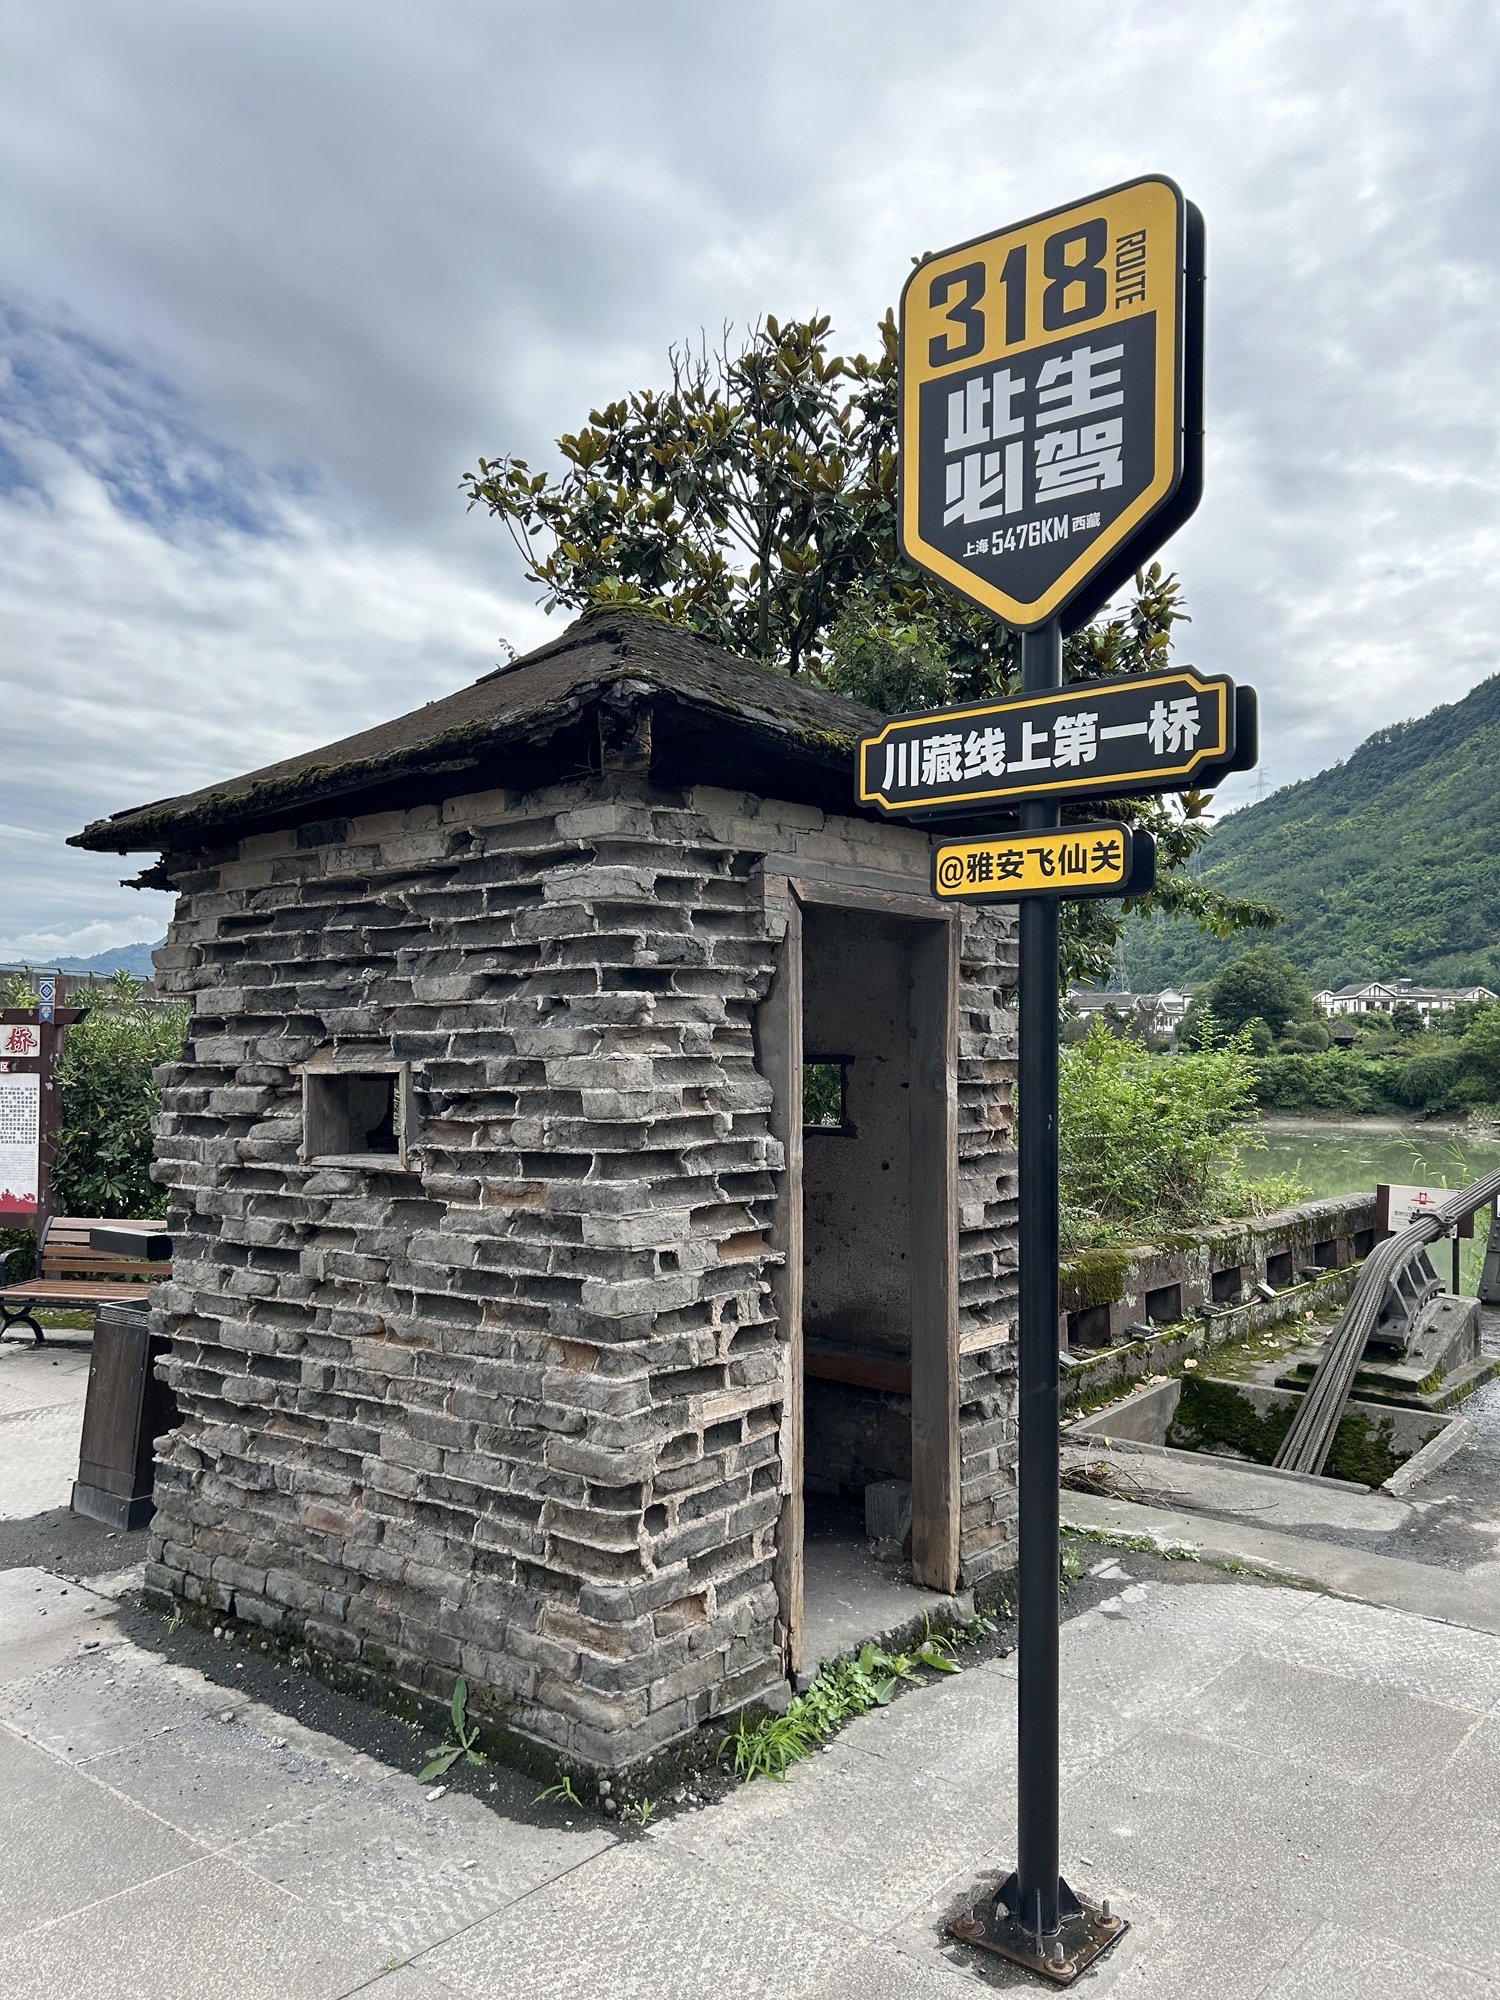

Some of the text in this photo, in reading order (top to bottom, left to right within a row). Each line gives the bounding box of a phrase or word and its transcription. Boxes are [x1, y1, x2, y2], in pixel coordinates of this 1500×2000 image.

[929, 217, 1108, 368] 318
[1115, 229, 1147, 310] ROUTE
[944, 343, 1125, 453] 此生
[943, 417, 1124, 527] 必驾
[962, 511, 1101, 557] 上海 5476KM 西藏
[881, 696, 1202, 791] 川藏线上第一桥
[938, 839, 1122, 889] @雅安飞仙关
